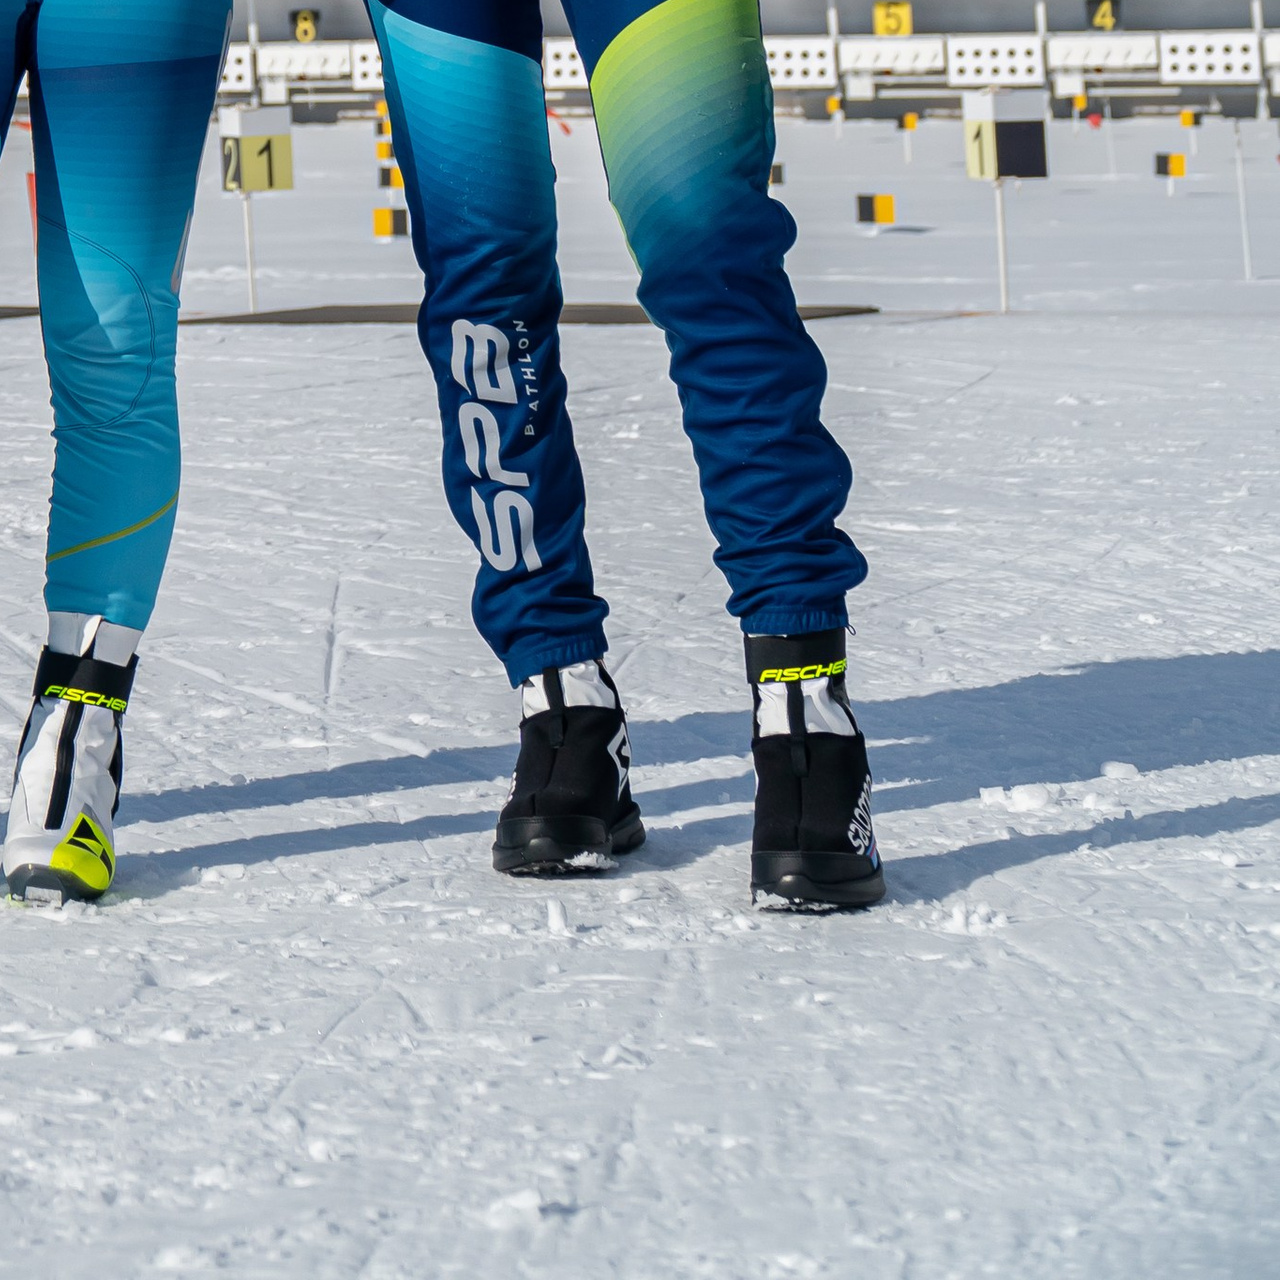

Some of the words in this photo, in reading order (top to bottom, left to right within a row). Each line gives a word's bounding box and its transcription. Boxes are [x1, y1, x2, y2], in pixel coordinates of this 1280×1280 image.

[295, 9, 317, 43] 8
[883, 2, 903, 34] 5
[223, 139, 239, 190] 2
[257, 139, 274, 188] 1
[973, 122, 985, 177] 1
[451, 319, 543, 572] SPB
[759, 658, 849, 684] FISCHER
[44, 685, 127, 713] FISCHER
